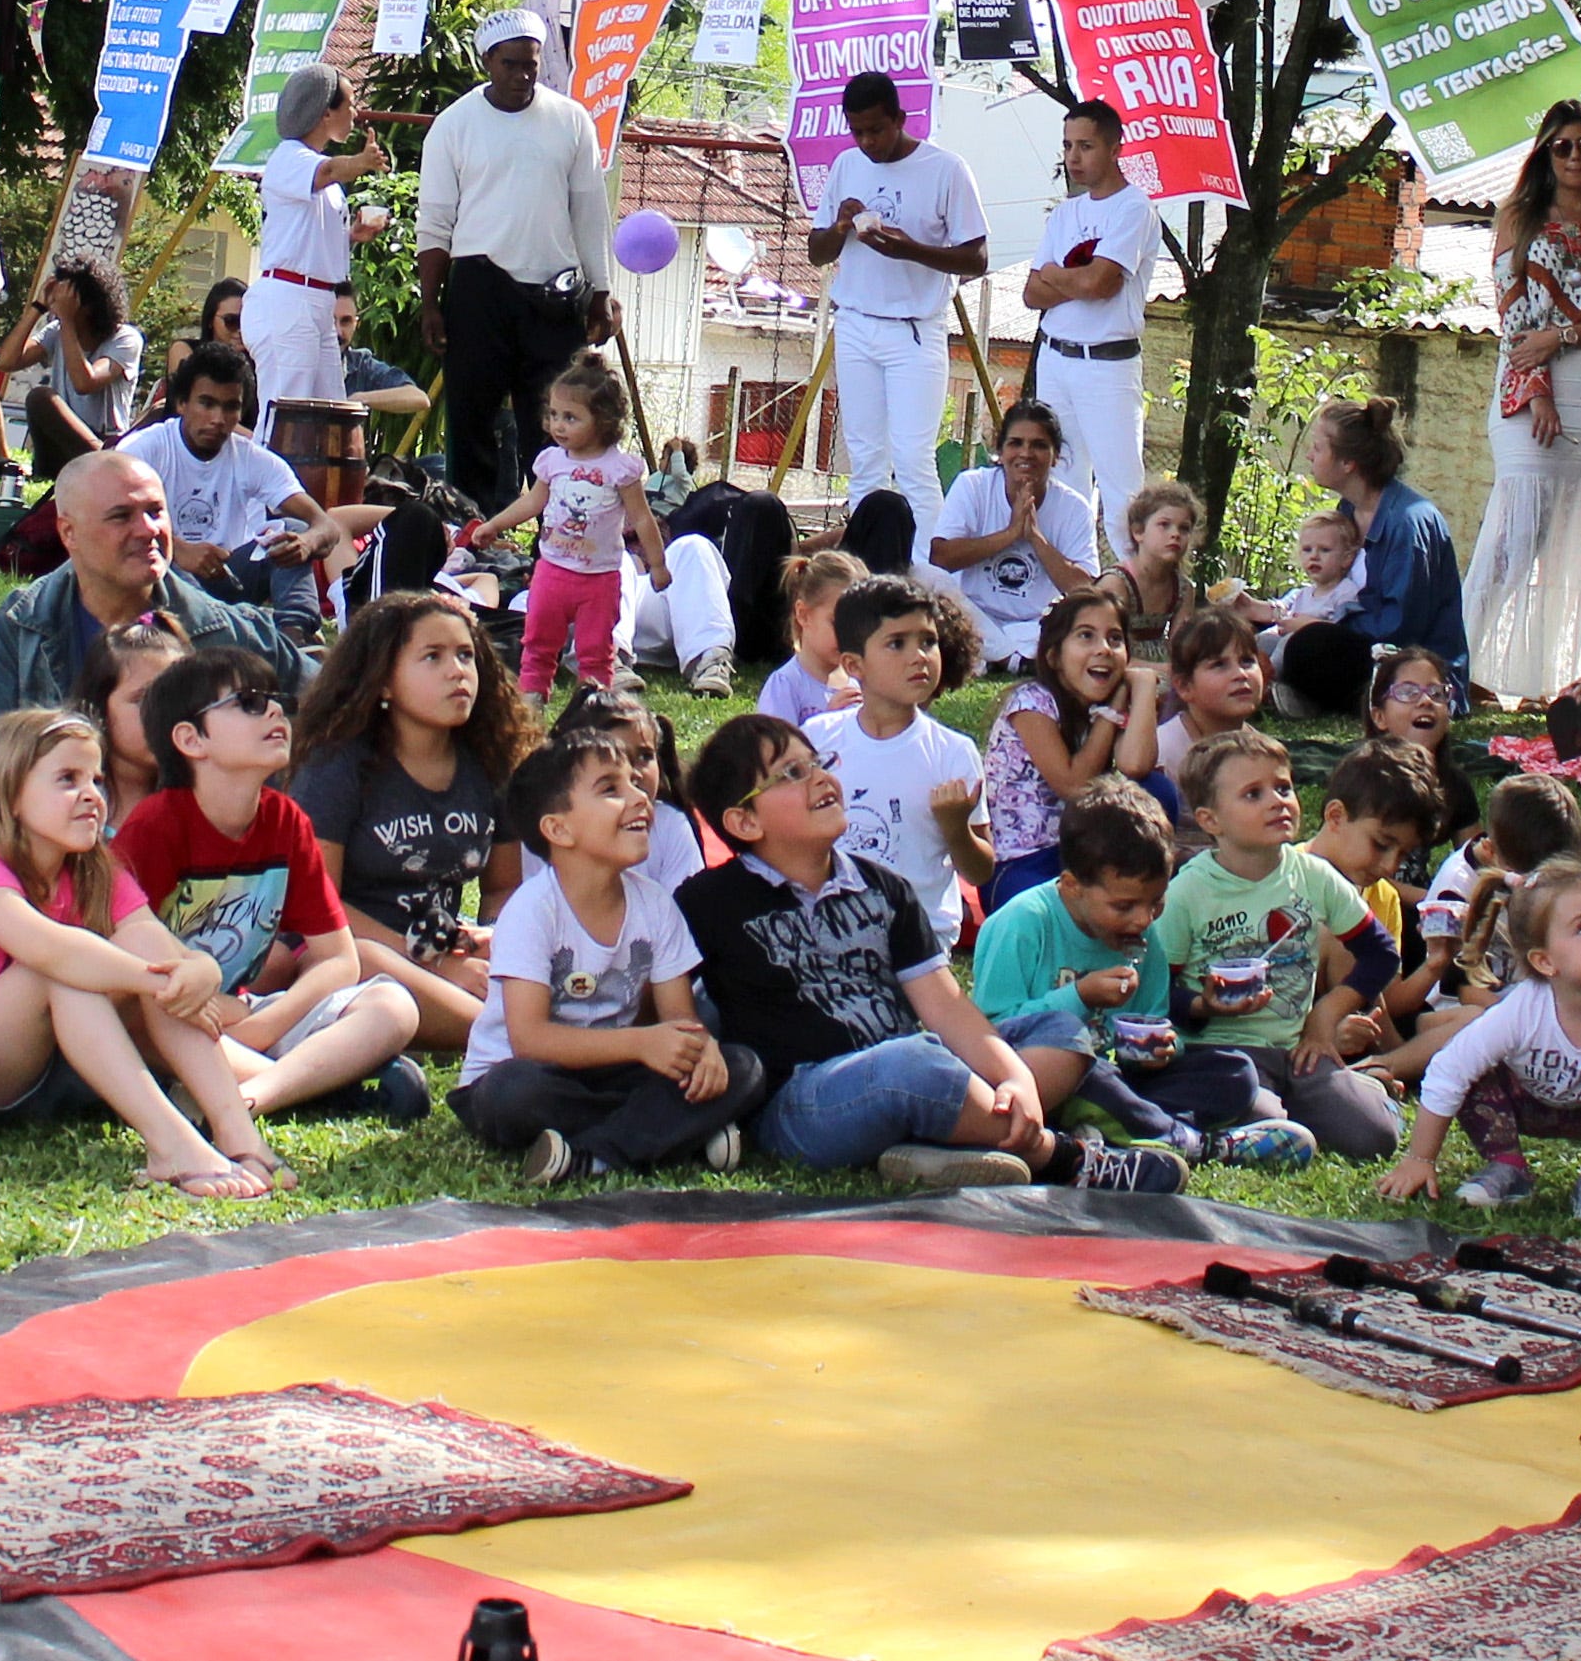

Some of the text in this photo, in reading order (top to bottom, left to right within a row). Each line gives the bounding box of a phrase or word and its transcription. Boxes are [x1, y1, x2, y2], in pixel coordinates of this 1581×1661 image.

[726, 0, 760, 11] GRITAR
[958, 7, 971, 18] DE
[799, 30, 920, 82] LUMINOSO
[1096, 27, 1195, 59] O RITMO DA
[1379, 21, 1453, 71] ESTÃO
[1112, 55, 1199, 111] RUA
[1398, 33, 1567, 114] DE TENTAÇÕES
[796, 105, 822, 139] RI
[1161, 113, 1218, 139] CONVIDA
[373, 812, 434, 846] WISH
[444, 812, 478, 835] ON
[743, 909, 818, 966] YOU
